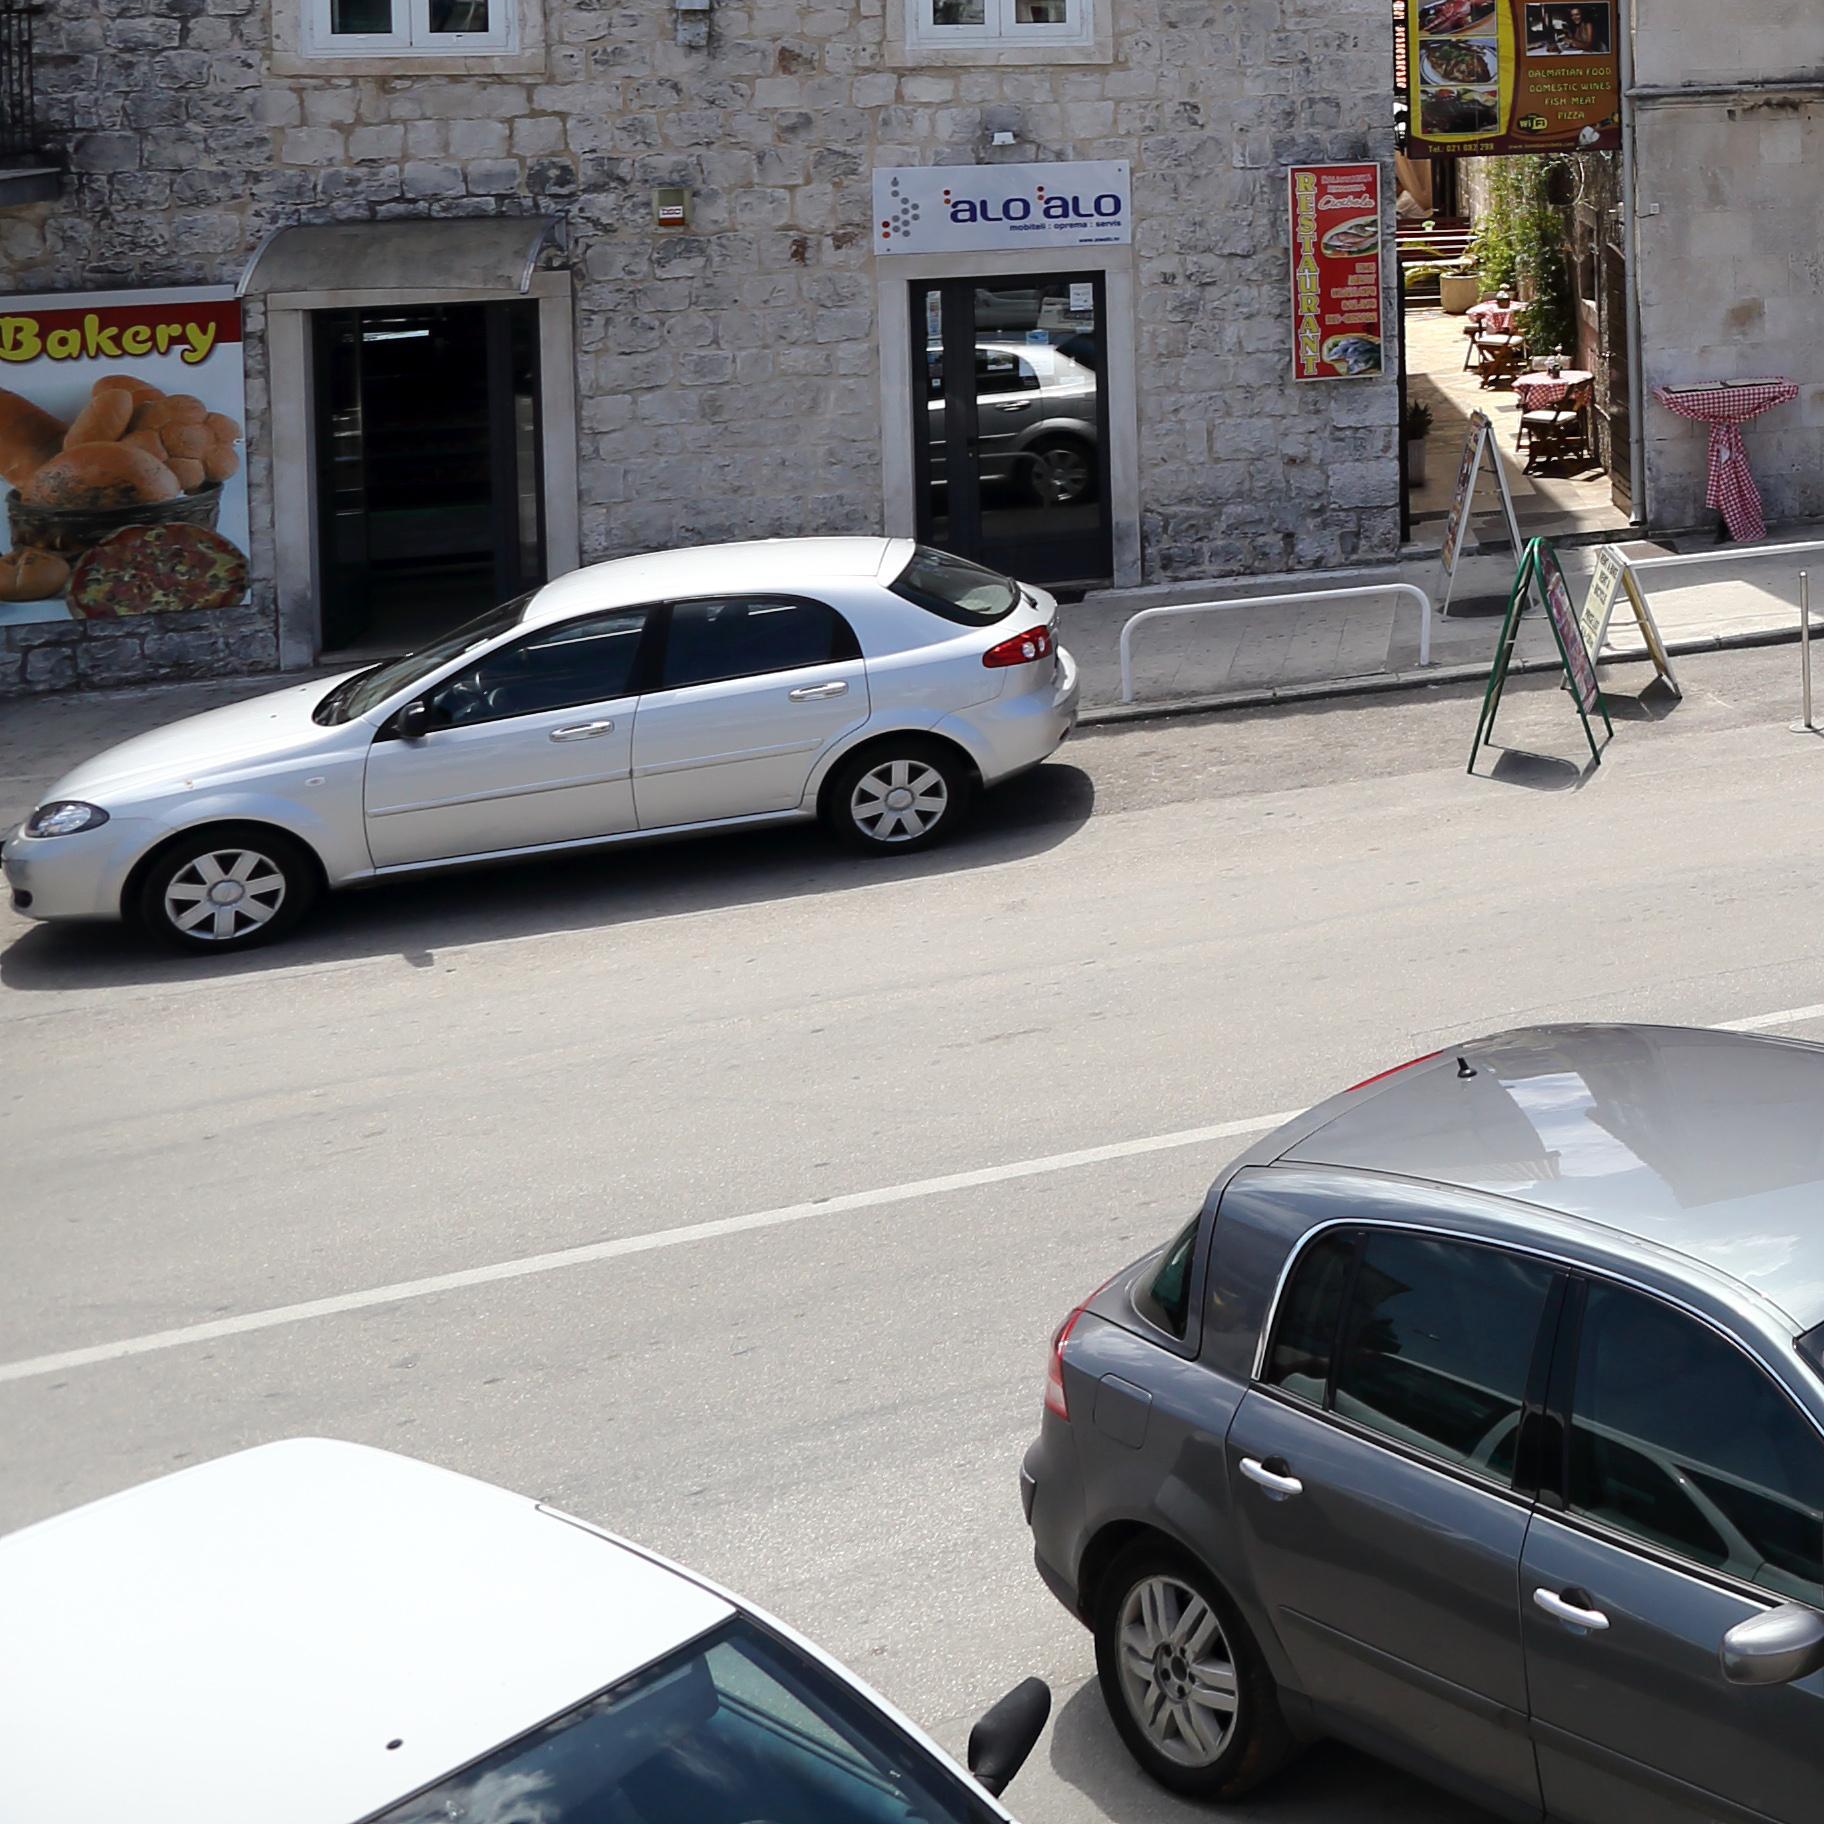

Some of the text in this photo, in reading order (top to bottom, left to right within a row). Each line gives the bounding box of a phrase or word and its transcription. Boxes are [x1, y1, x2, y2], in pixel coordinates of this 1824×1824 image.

[1528, 67, 1612, 78] DALMATIAN FOOD
[1529, 81, 1612, 93] DOMESTIC WINES
[1544, 96, 1597, 106] FISH MEAT
[1557, 111, 1585, 120] PIZZA
[1096, 220, 1122, 228] servis
[1295, 172, 1320, 375] RESTAURANT
[0, 314, 217, 364] Bakery
